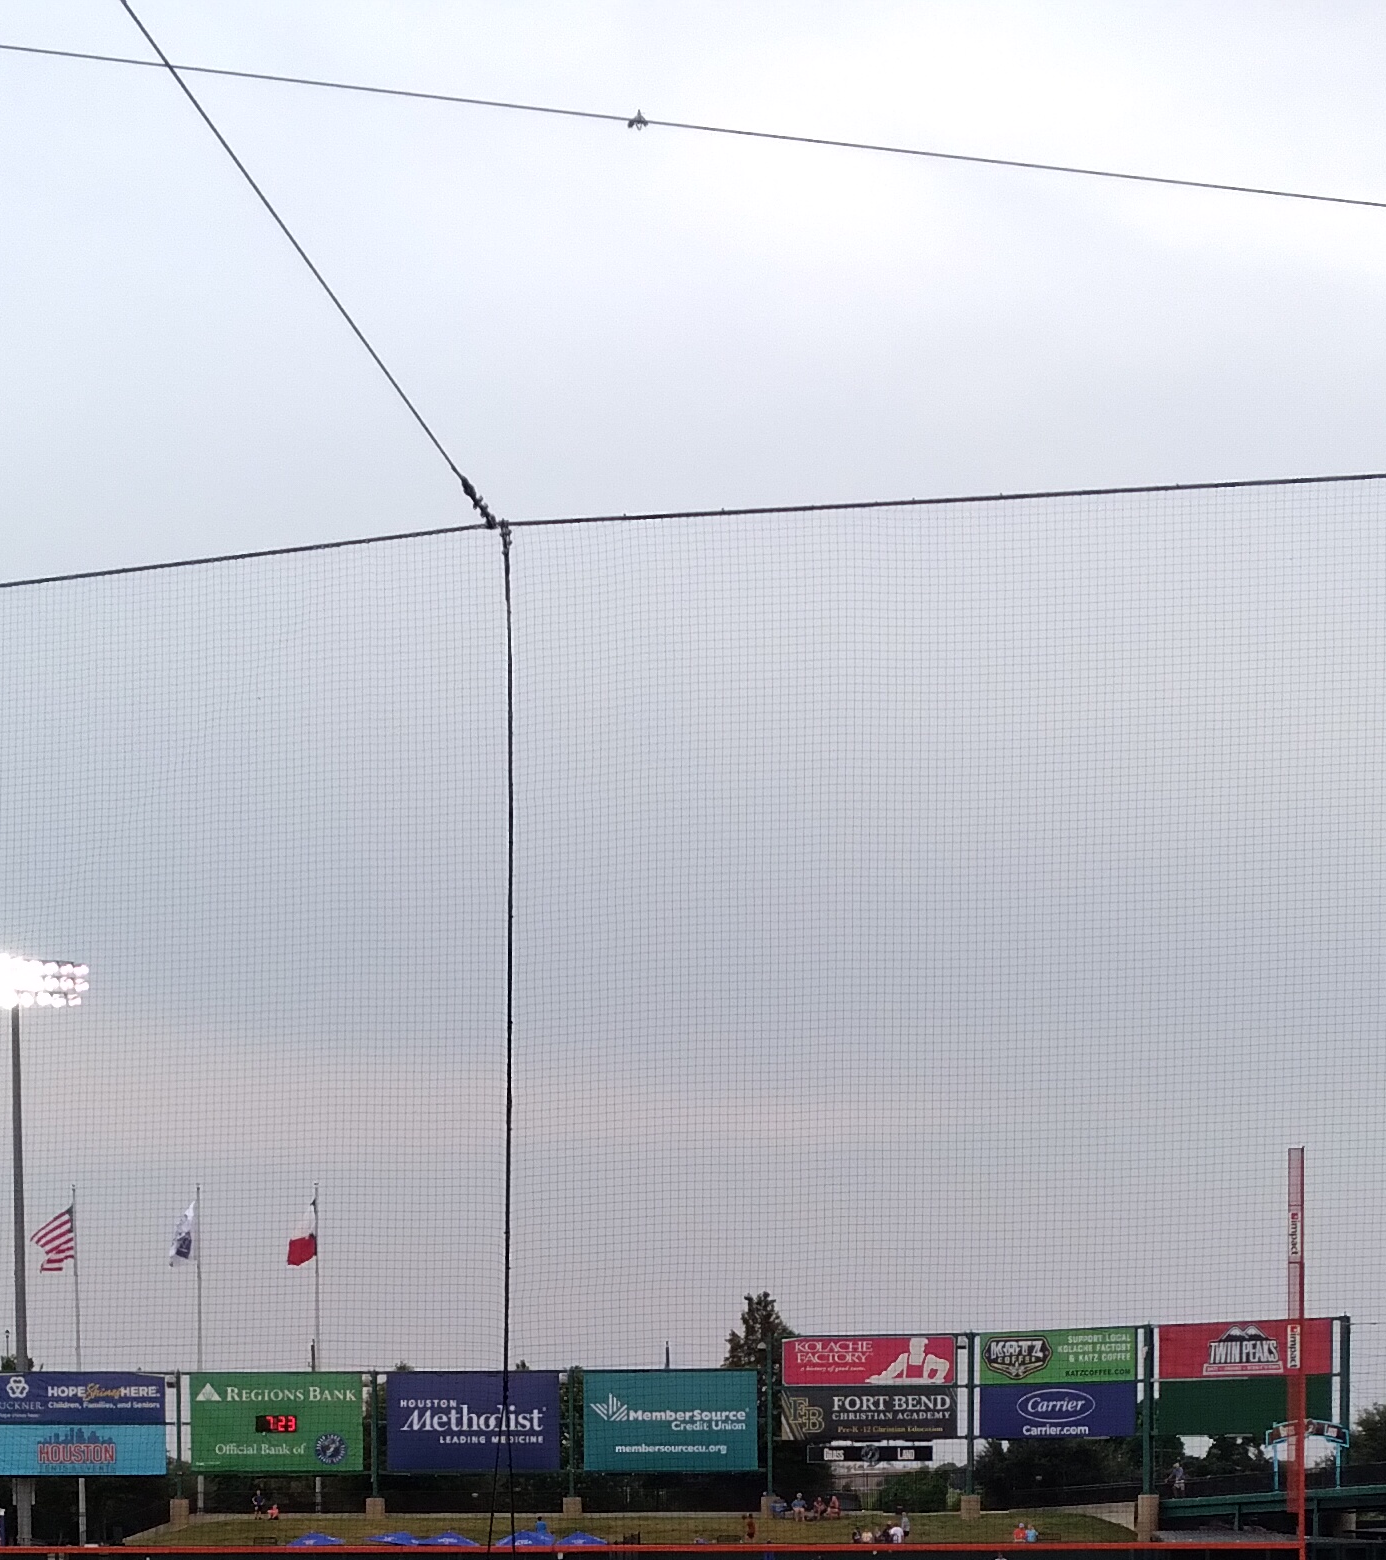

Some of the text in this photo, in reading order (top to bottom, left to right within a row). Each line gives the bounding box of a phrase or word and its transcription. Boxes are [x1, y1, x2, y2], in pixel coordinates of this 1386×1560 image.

[1068, 1334, 1131, 1343] SUPPORT LOCAL
[795, 1341, 872, 1352] KOLACHE
[991, 1341, 1043, 1358] KATZ
[1210, 1340, 1280, 1364] TWIN PEAKS
[1288, 1332, 1300, 1368] impact
[797, 1352, 868, 1363] FACTORY
[998, 1356, 1036, 1364] COFFEE
[1078, 1354, 1098, 1362] KATZ
[48, 1386, 160, 1397] HOPE HERE.
[226, 1386, 356, 1401] REGIONS BANK
[48, 1402, 82, 1410] Children,
[400, 1400, 457, 1408] HOUSTON
[832, 1395, 950, 1410] FORT BEND
[1028, 1396, 1085, 1412] Carrier
[400, 1405, 544, 1431] Methodist
[629, 1410, 746, 1420] MemberSource
[832, 1412, 950, 1420] CHRISTIAN ACADEMY
[266, 1416, 296, 1432] 7:23
[671, 1420, 746, 1430] Credit Union
[1023, 1424, 1088, 1436] Carrier.com
[38, 1444, 116, 1464] HOUSTON
[215, 1443, 306, 1455] Official Bank of
[616, 1444, 727, 1454] membersourcecu.org
